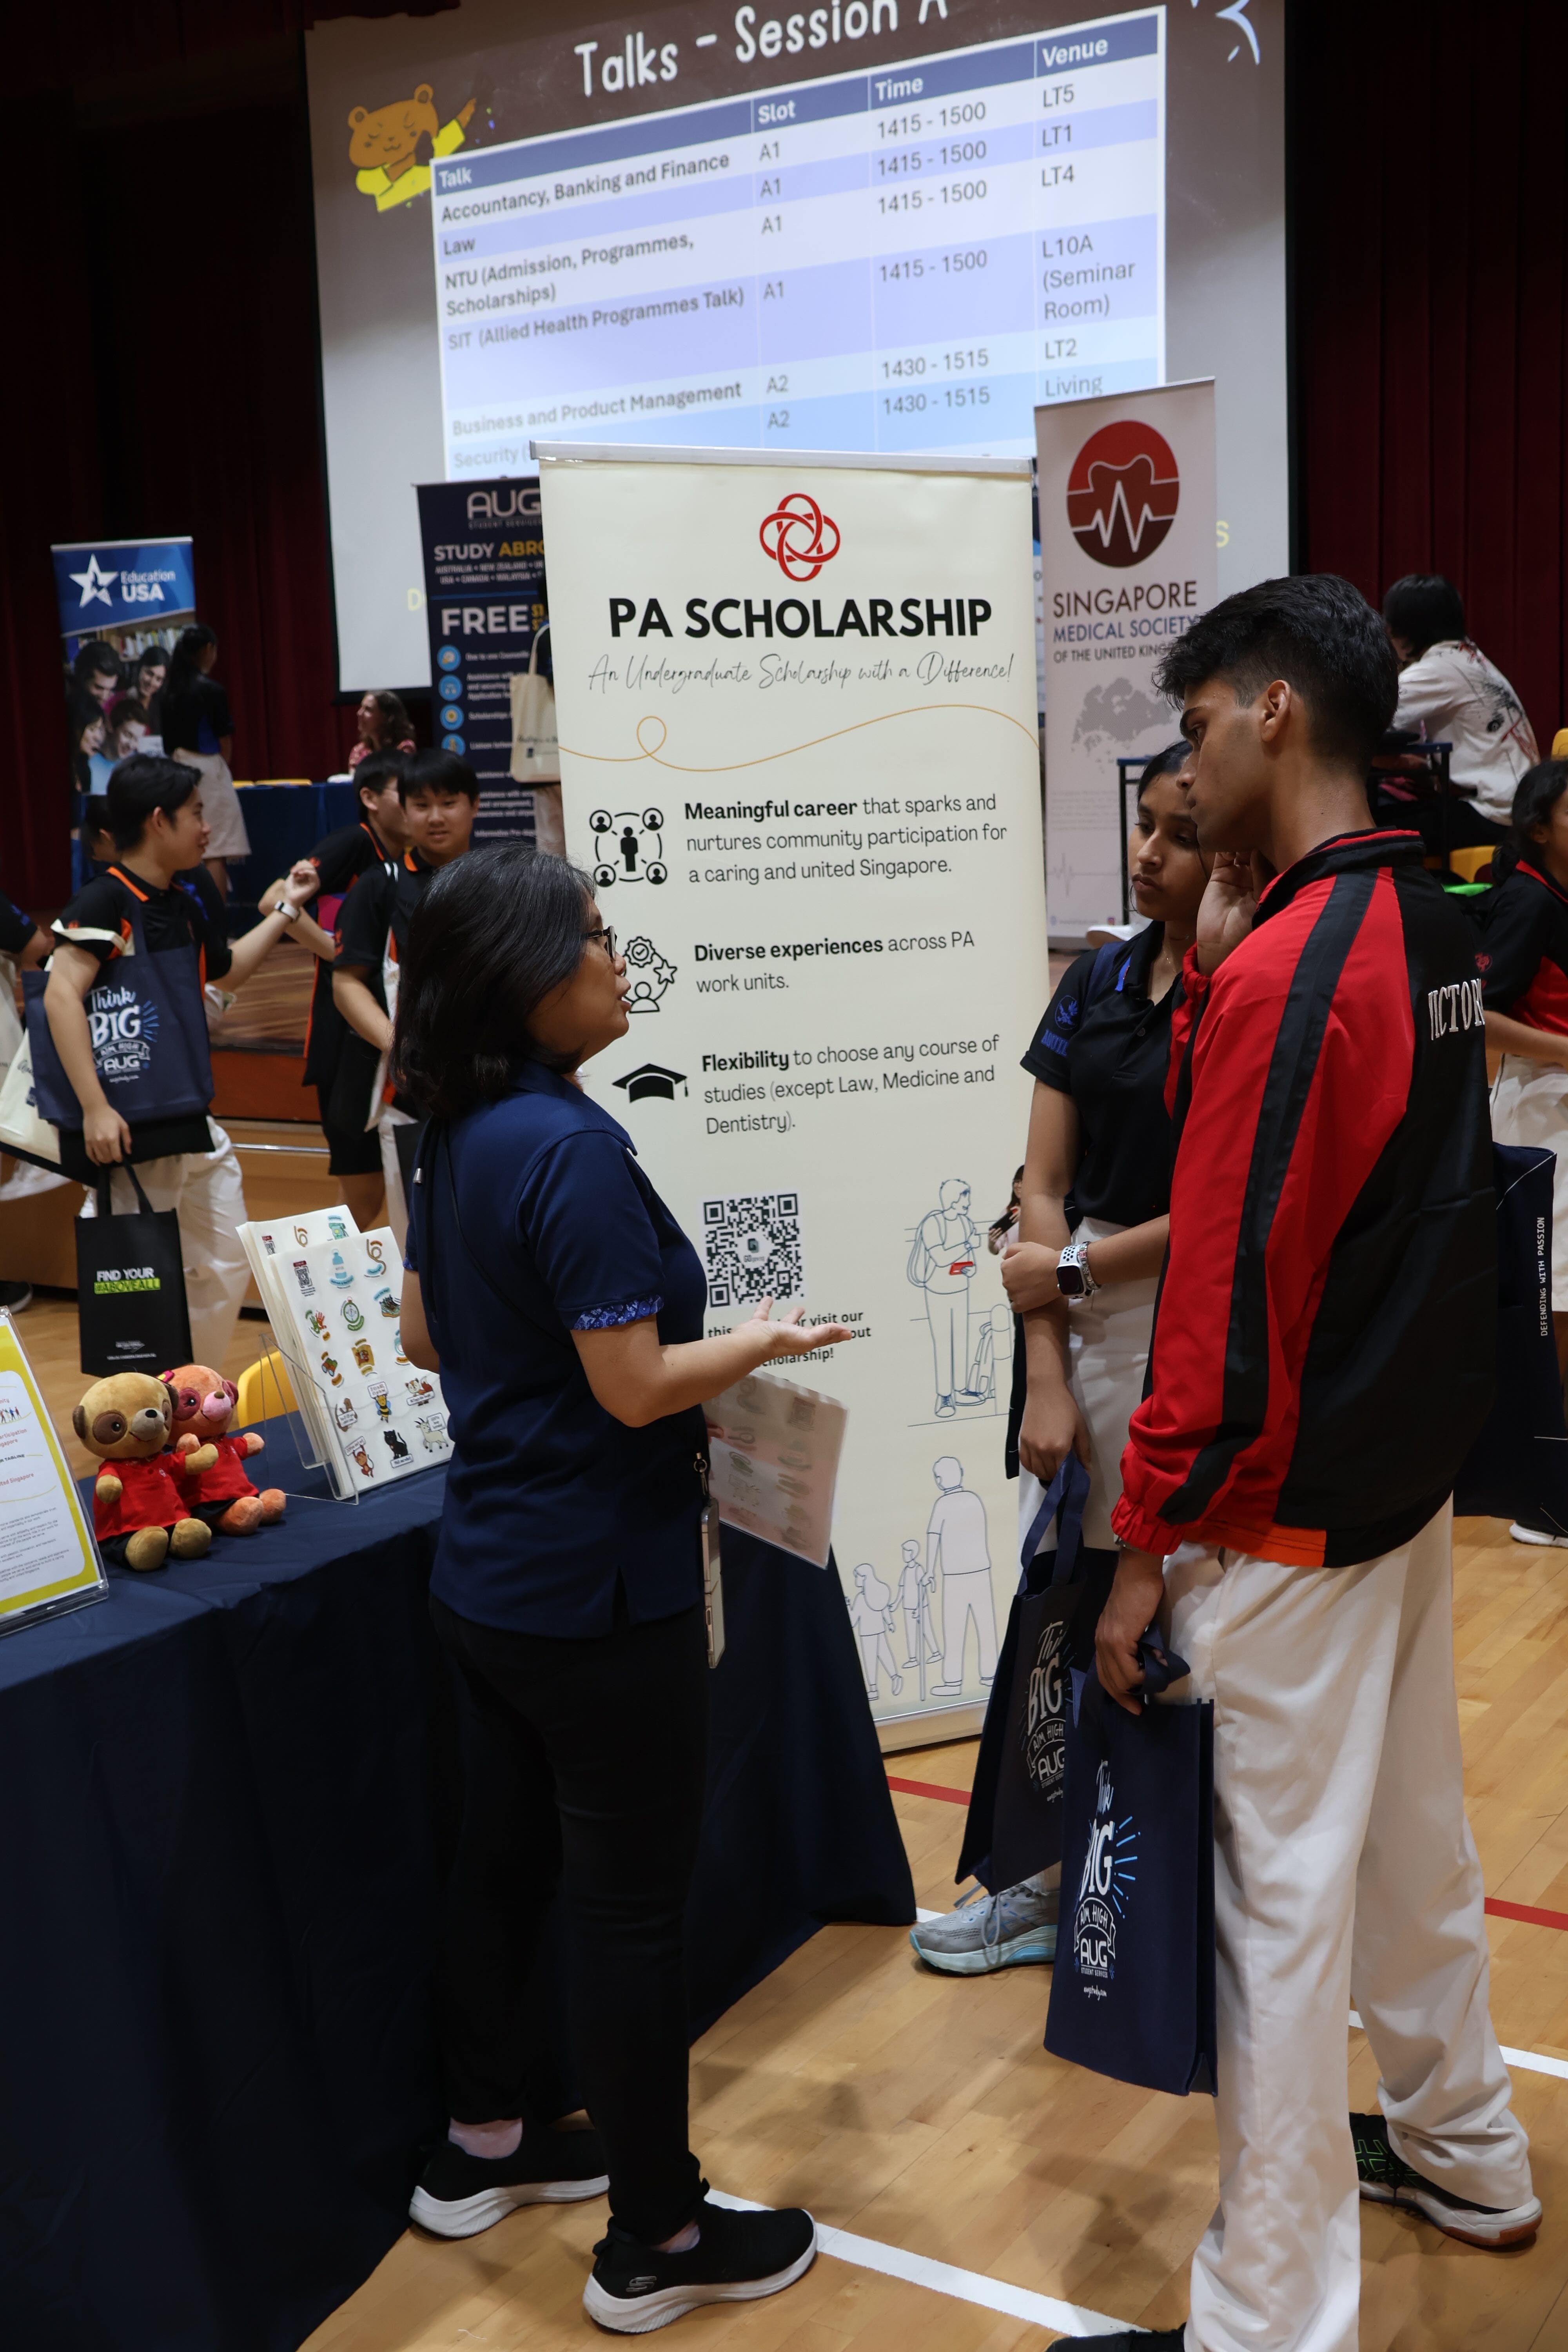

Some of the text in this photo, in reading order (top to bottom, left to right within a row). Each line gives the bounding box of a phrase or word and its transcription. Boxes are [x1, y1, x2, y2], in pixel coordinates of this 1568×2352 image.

[575, 0, 898, 97] Talks - Session
[1042, 38, 1109, 68] Venue
[875, 76, 923, 102] Time
[1042, 84, 1074, 108] LT5
[758, 100, 796, 123] Slot
[877, 115, 922, 140] 1415
[939, 102, 986, 126] 1500
[1042, 125, 1073, 148] LT1
[759, 141, 780, 161] A1
[877, 153, 922, 177] 1415
[940, 141, 987, 163] 1500
[439, 167, 472, 189] Talk
[441, 153, 729, 223] Accountancy, Banking and Finance
[760, 178, 781, 198] A1
[1042, 165, 1074, 187] LT4
[877, 192, 922, 214] 1415
[940, 180, 987, 203] 1500
[761, 215, 782, 234] A1
[443, 238, 476, 256] Law
[1042, 236, 1093, 258] L10A
[445, 233, 694, 290] NTU (Admission, Programmes,
[880, 260, 925, 282] 1415
[940, 249, 988, 272] 1500
[764, 281, 784, 299] A1
[1042, 261, 1135, 292] (Seminar
[446, 282, 555, 317] Scholarships)
[1044, 292, 1109, 322] Room)
[448, 286, 744, 350] SIT (Allied Health Programmes Talk)
[1044, 339, 1077, 360] LT2
[882, 357, 926, 379] 1430
[942, 348, 989, 371] 1515
[767, 375, 788, 394] A2
[1044, 375, 1102, 397] Living
[453, 381, 741, 437] Business and Product Management
[883, 394, 927, 416] 1430
[944, 386, 990, 408] 1515
[768, 411, 789, 430] A2
[454, 446, 518, 468] Security
[467, 488, 541, 520] AUG
[434, 542, 495, 561] STUDY
[121, 570, 175, 584] Education
[122, 584, 165, 603] USA
[1053, 581, 1197, 619] SINGAPORE
[441, 604, 530, 636] FREE
[609, 598, 992, 638] PA SCHOLARSHIP
[1053, 622, 1124, 643] MEDICAL
[1054, 651, 1069, 664] OF
[1072, 649, 1091, 662] THE
[1094, 646, 1136, 661] UNITED
[588, 651, 1014, 694] An Undergraduate Scholarship with a Difference!
[685, 793, 996, 823] Meaningful career that sparks and
[687, 823, 1007, 851] nurtures community participation for
[689, 858, 952, 885] a caring and united Singapore.
[695, 931, 975, 962] Diverse experiences across PA
[696, 973, 789, 993] work units.
[85, 985, 136, 1012] Think
[87, 1005, 142, 1048] BIG
[104, 1054, 140, 1071] AUG
[702, 1035, 1000, 1072] Flexibility to choose any course of
[704, 1065, 996, 1104] studies (except Law, Medicine and
[706, 1111, 795, 1134] Dentistry).
[97, 1267, 154, 1282] FIND YOUR
[708, 1326, 733, 1338] this
[809, 1314, 837, 1327] visit
[842, 1311, 864, 1323] our
[1028, 1652, 1063, 1736] BIG
[1033, 1723, 1063, 1752] AIM HIGH
[1038, 1747, 1065, 1780] AUG
[1080, 1902, 1108, 1929] AIM HIGH
[1080, 1937, 1108, 1969] AUG
[1081, 1966, 1094, 1977] STUDENT
